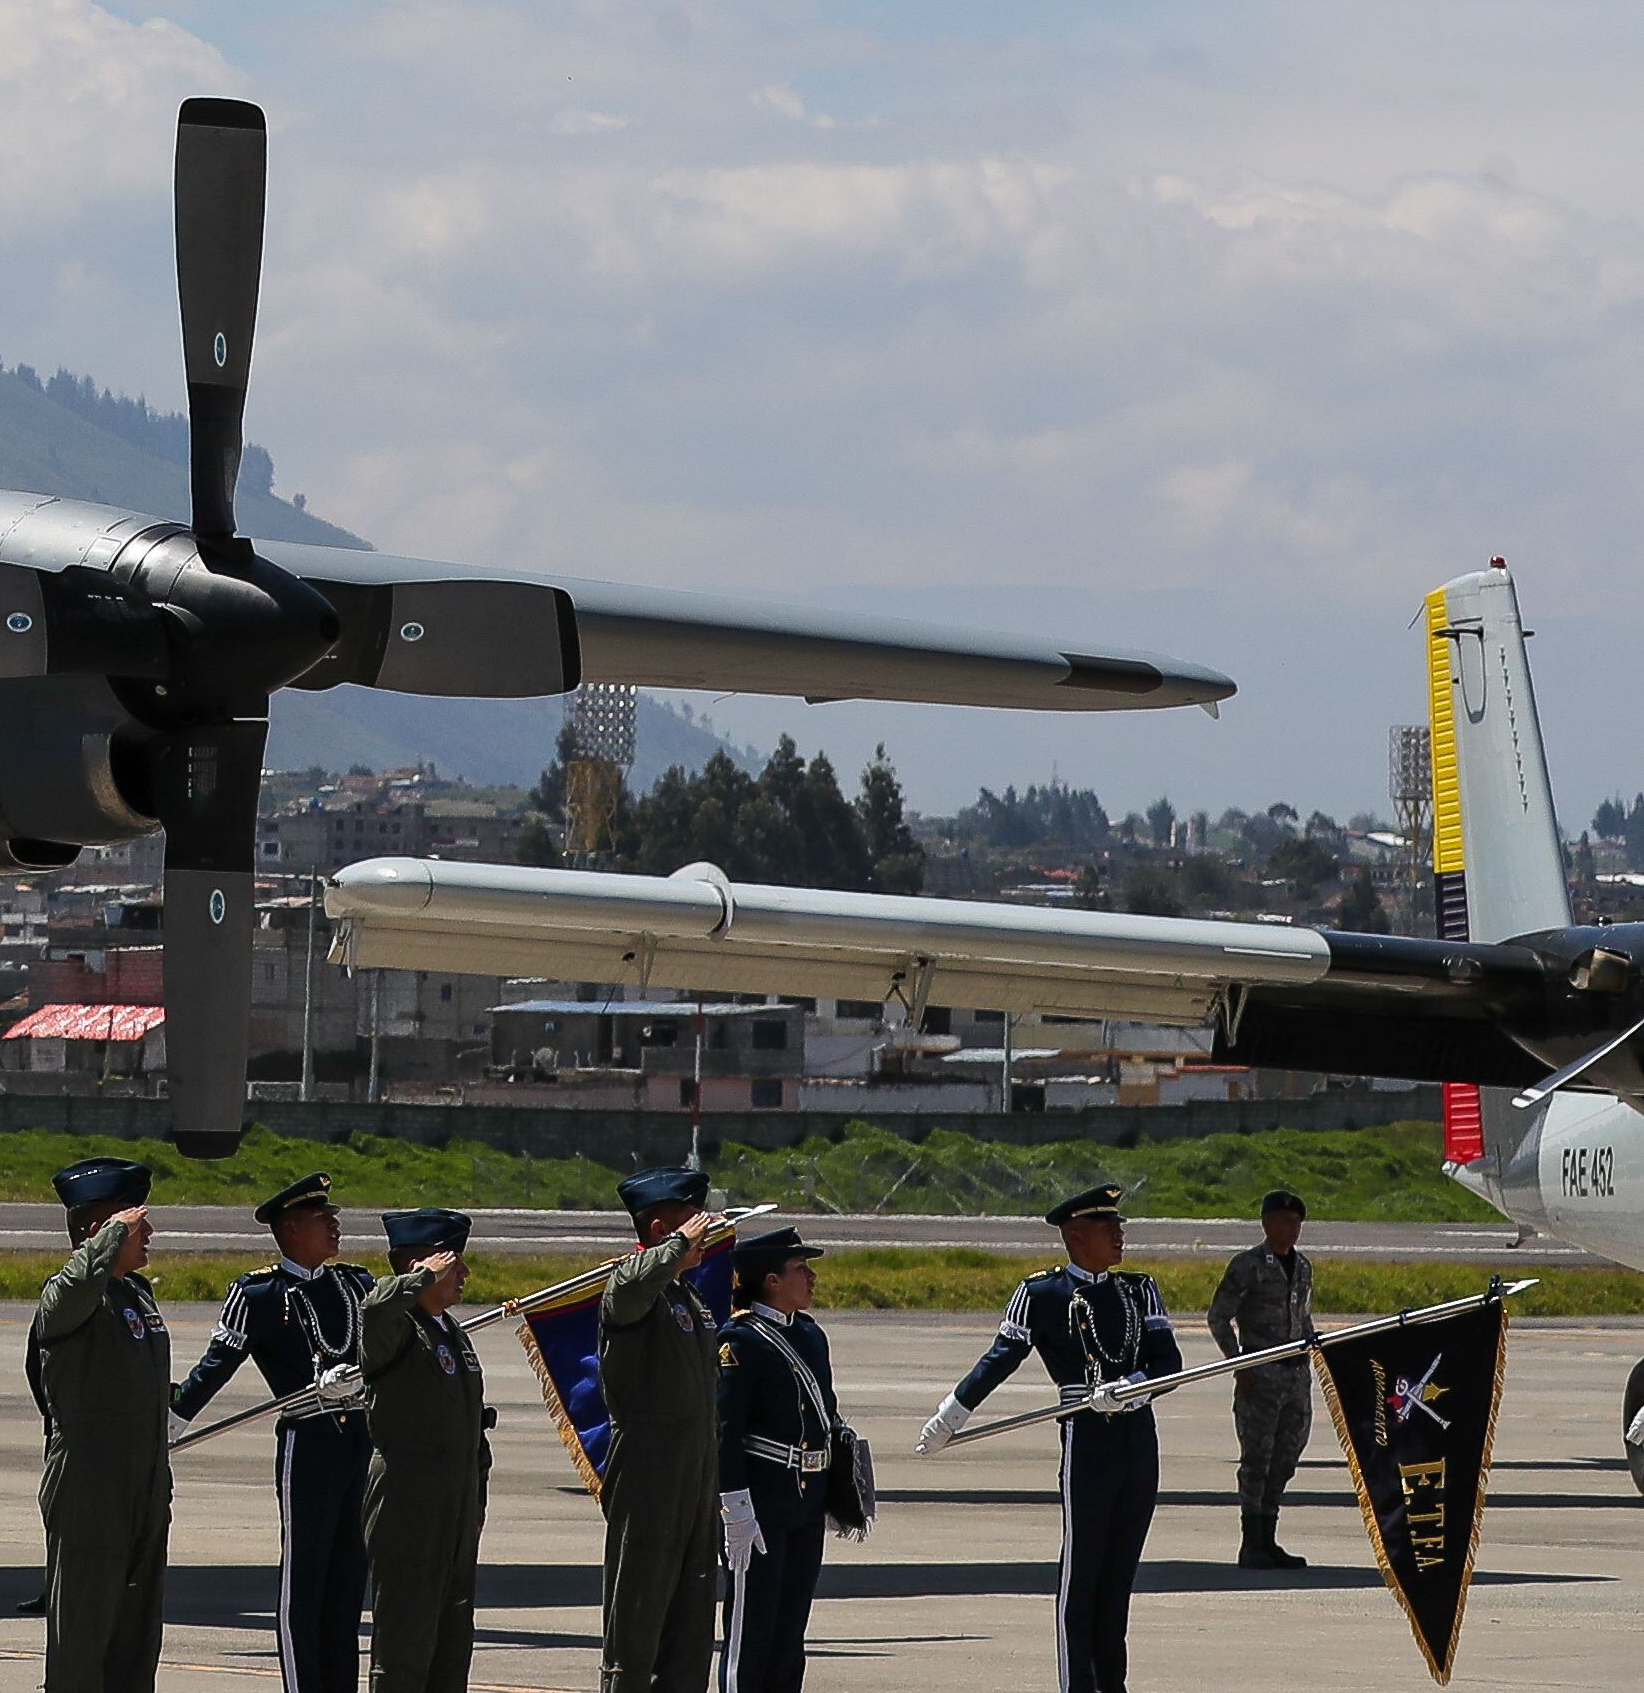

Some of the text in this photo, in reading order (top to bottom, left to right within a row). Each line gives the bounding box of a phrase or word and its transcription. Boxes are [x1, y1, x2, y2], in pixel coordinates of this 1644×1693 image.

[1562, 1146, 1615, 1197] FAE 452
[1369, 1358, 1389, 1447] ARMAMENTO
[1397, 1456, 1446, 1572] E.T.F.A.
